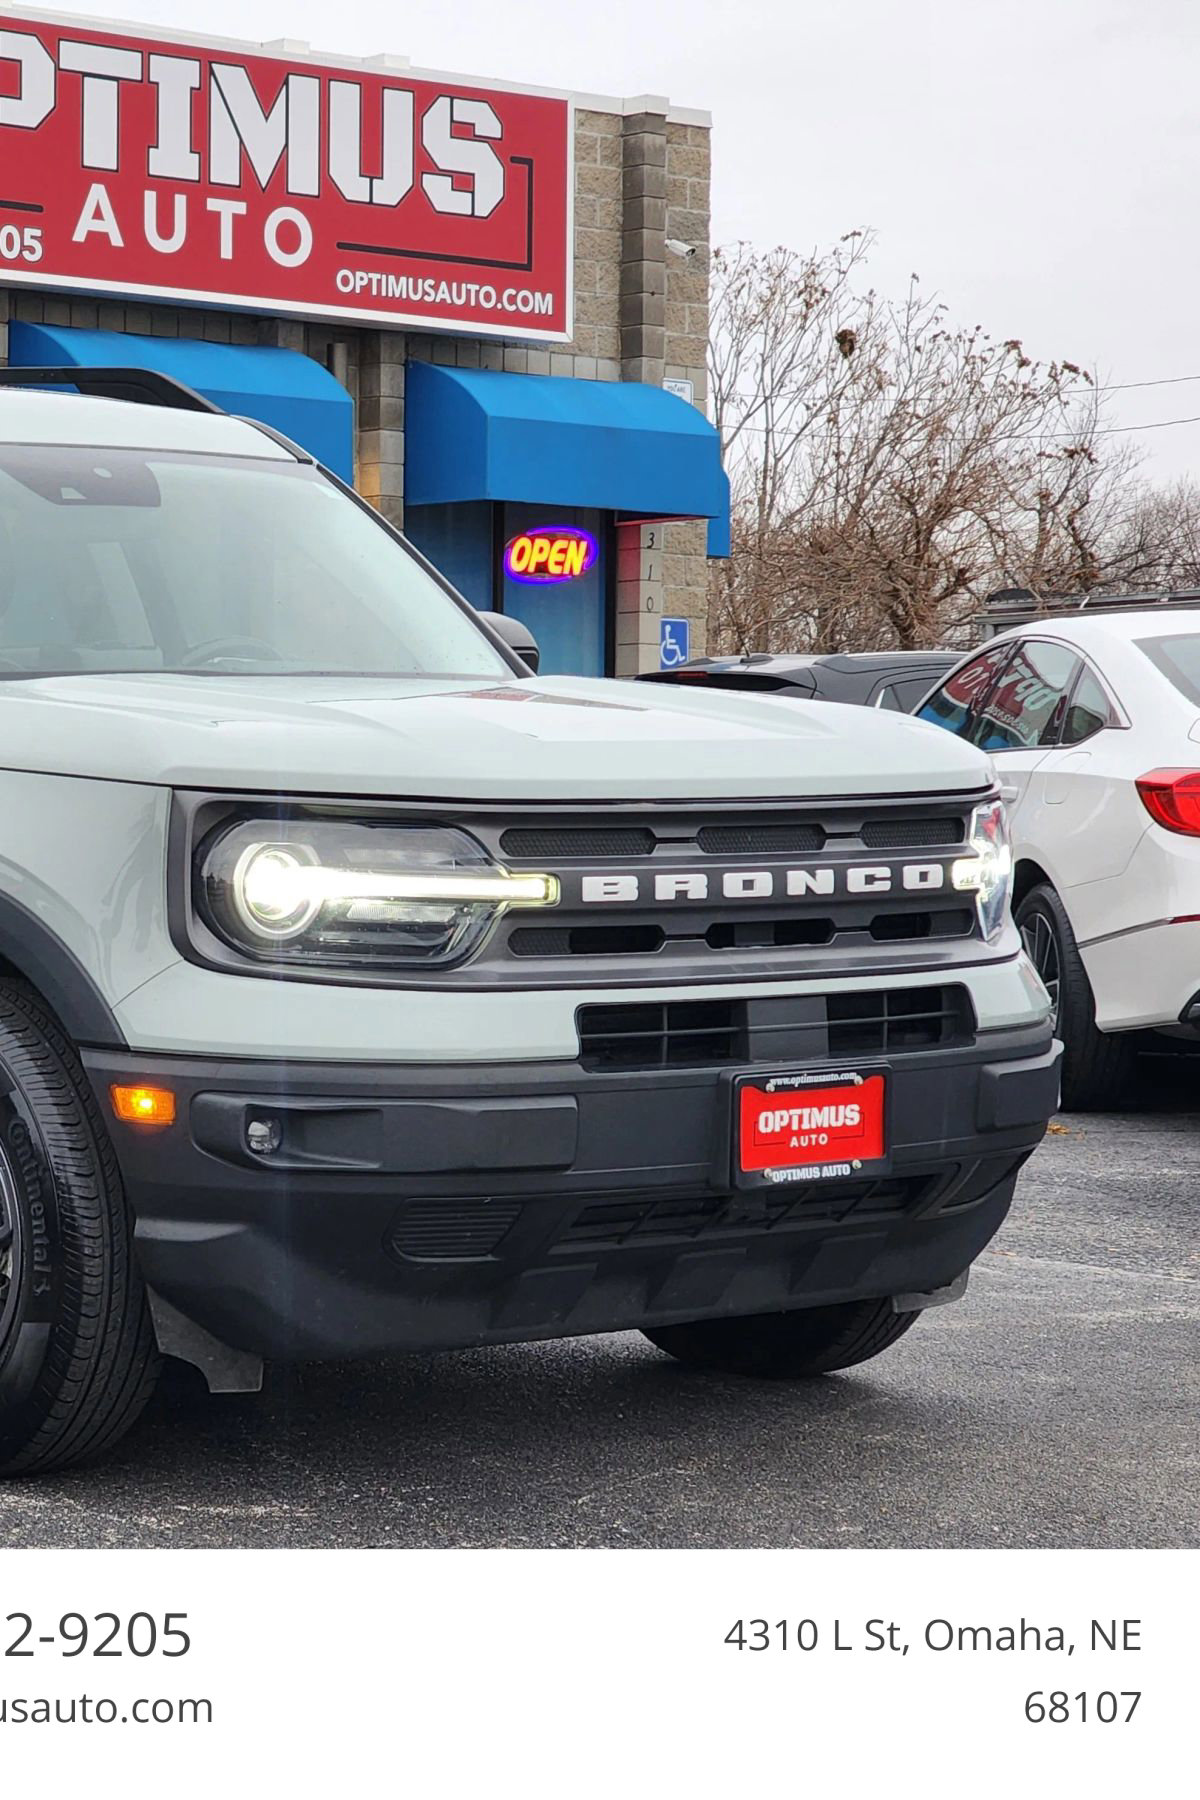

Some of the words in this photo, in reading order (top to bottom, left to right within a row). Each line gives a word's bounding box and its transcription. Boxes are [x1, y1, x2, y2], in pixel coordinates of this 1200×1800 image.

[71, 183, 313, 268] AUTO
[335, 269, 554, 315] OPTIMUSAUTO.COM
[510, 536, 588, 576] OPEN
[581, 863, 943, 902] BRONCO
[769, 1073, 858, 1086] www.optimusauto.com
[758, 1104, 861, 1133] OPTIMUS
[789, 1133, 828, 1148] AUTO
[772, 1167, 821, 1182] OPTIMUS
[822, 1163, 851, 1177] AUTO
